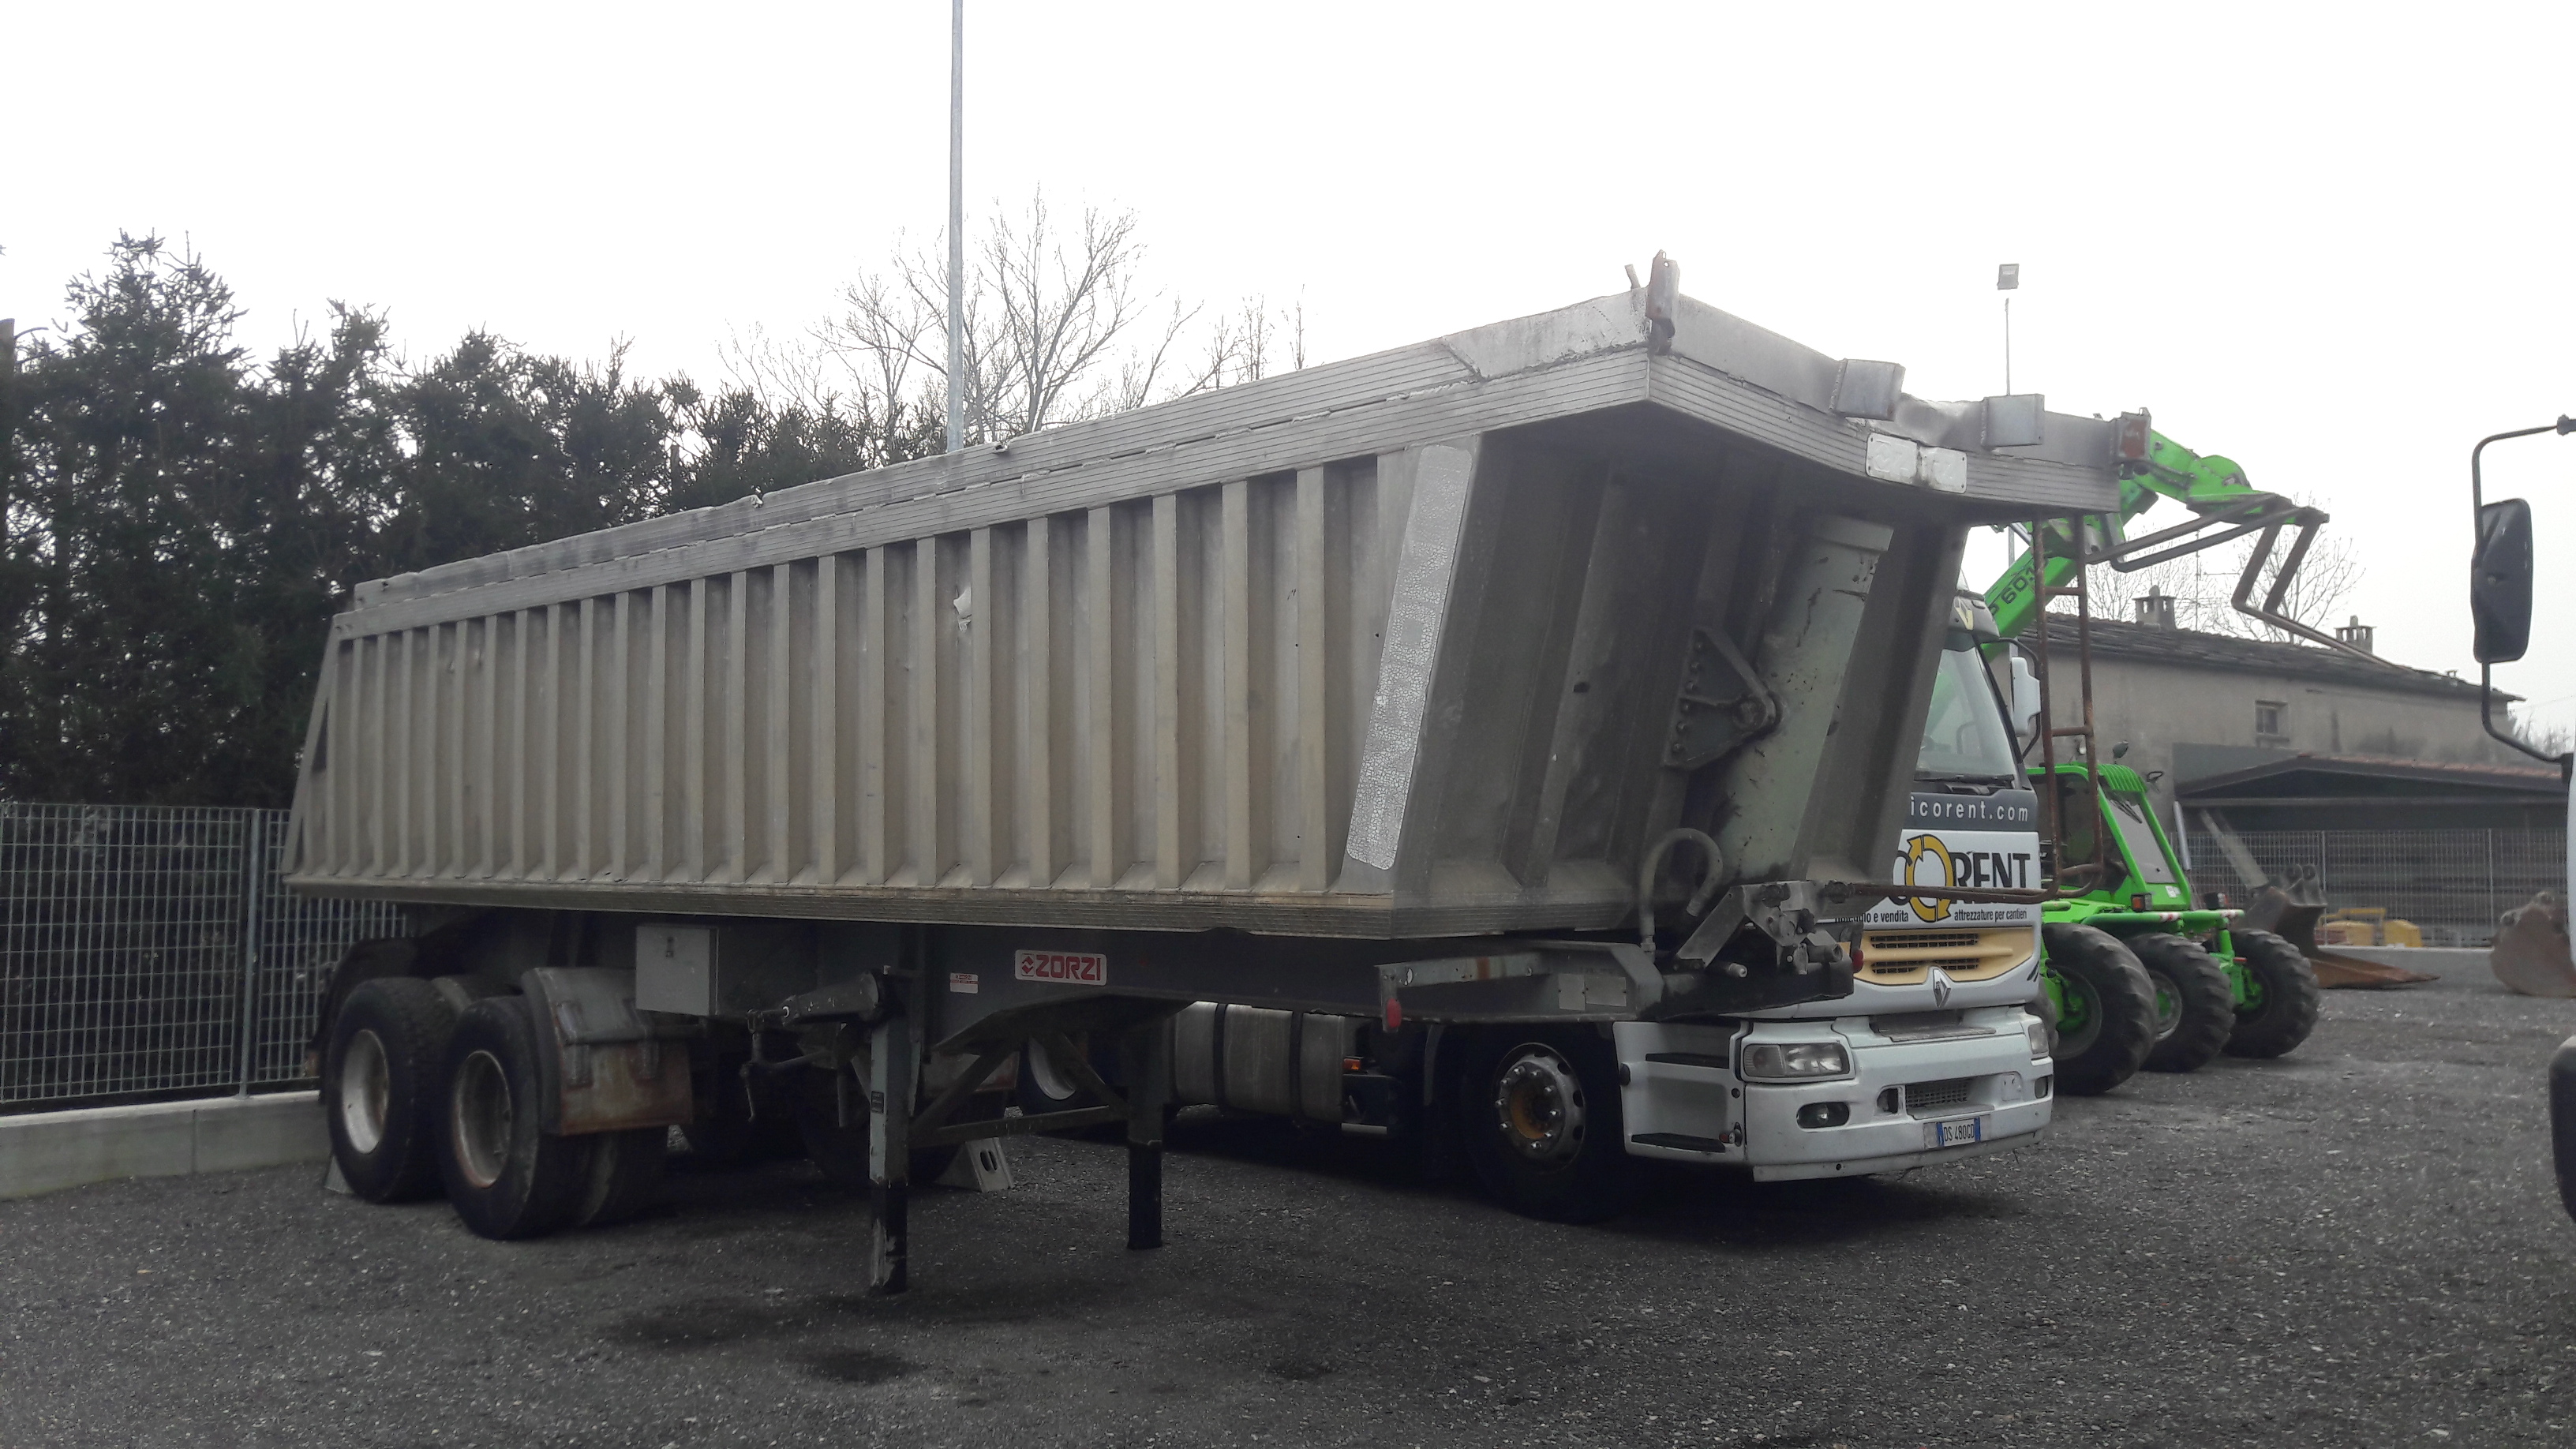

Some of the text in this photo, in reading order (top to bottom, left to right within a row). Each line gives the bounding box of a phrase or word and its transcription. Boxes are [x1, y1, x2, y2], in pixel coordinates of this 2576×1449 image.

[1874, 913, 1878, 923] e
[1880, 910, 1909, 923] vendita
[1954, 908, 2027, 923] attrezzature per cantieri
[1035, 953, 1102, 981] ZORZI
